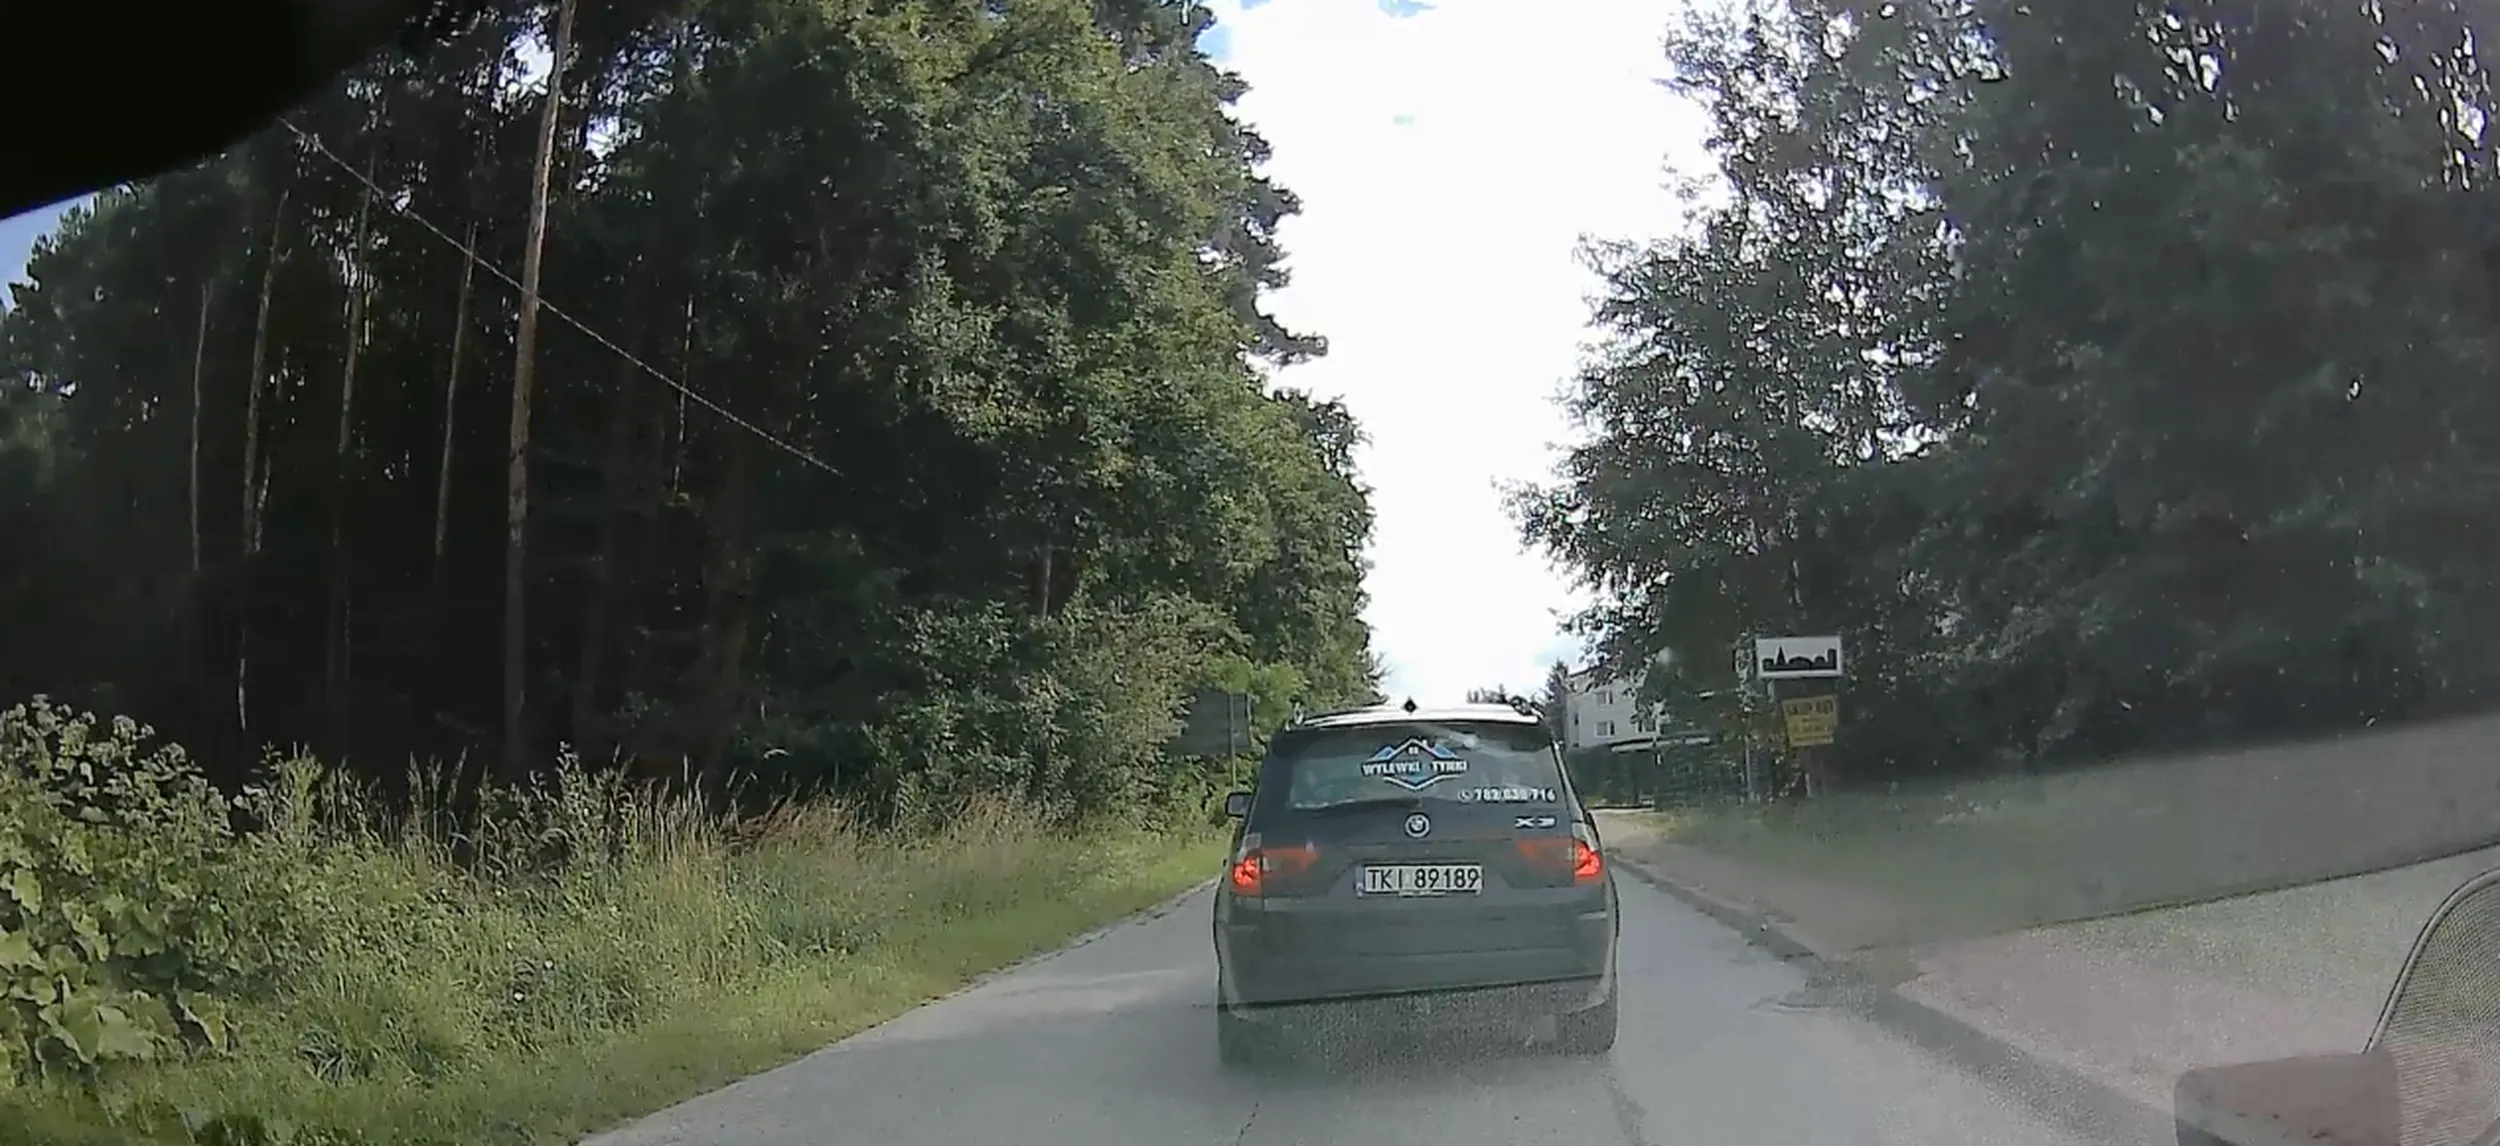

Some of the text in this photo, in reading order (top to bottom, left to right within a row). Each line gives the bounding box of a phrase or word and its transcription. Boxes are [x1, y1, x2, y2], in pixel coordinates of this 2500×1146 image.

[1362, 761, 1421, 775] WYLEWKI
[1530, 787, 1556, 801] 716
[1514, 817, 1556, 828] X3
[1367, 867, 1479, 889] TKI 89189
